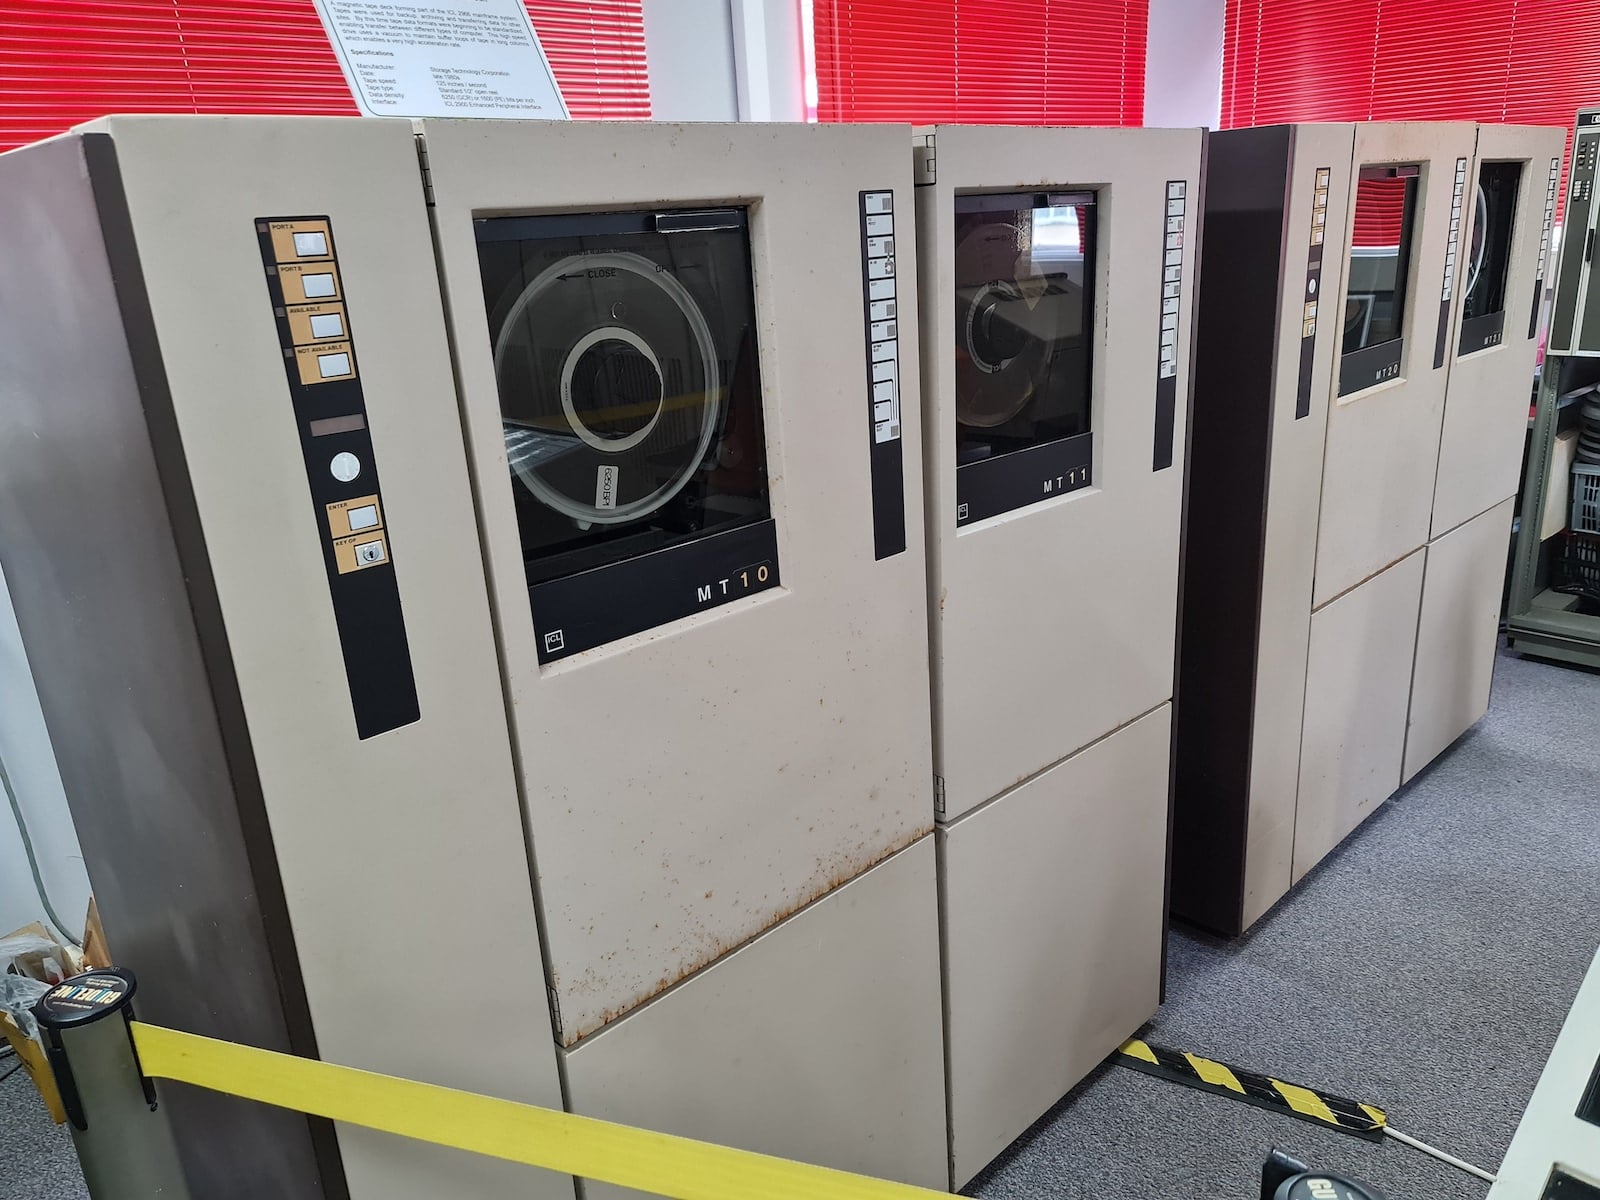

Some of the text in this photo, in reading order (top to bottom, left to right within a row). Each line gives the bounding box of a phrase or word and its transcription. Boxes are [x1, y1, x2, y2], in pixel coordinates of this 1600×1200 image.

[587, 269, 616, 279] CLOSE
[312, 344, 343, 354] AVAILABLE
[1376, 363, 1398, 380] MT20
[604, 468, 612, 490] 6250
[1044, 468, 1086, 493] MT11
[698, 566, 769, 603] MT10
[547, 634, 561, 644] ICL
[48, 985, 122, 1004] GUIDELINE
[1307, 1178, 1338, 1200] GU
